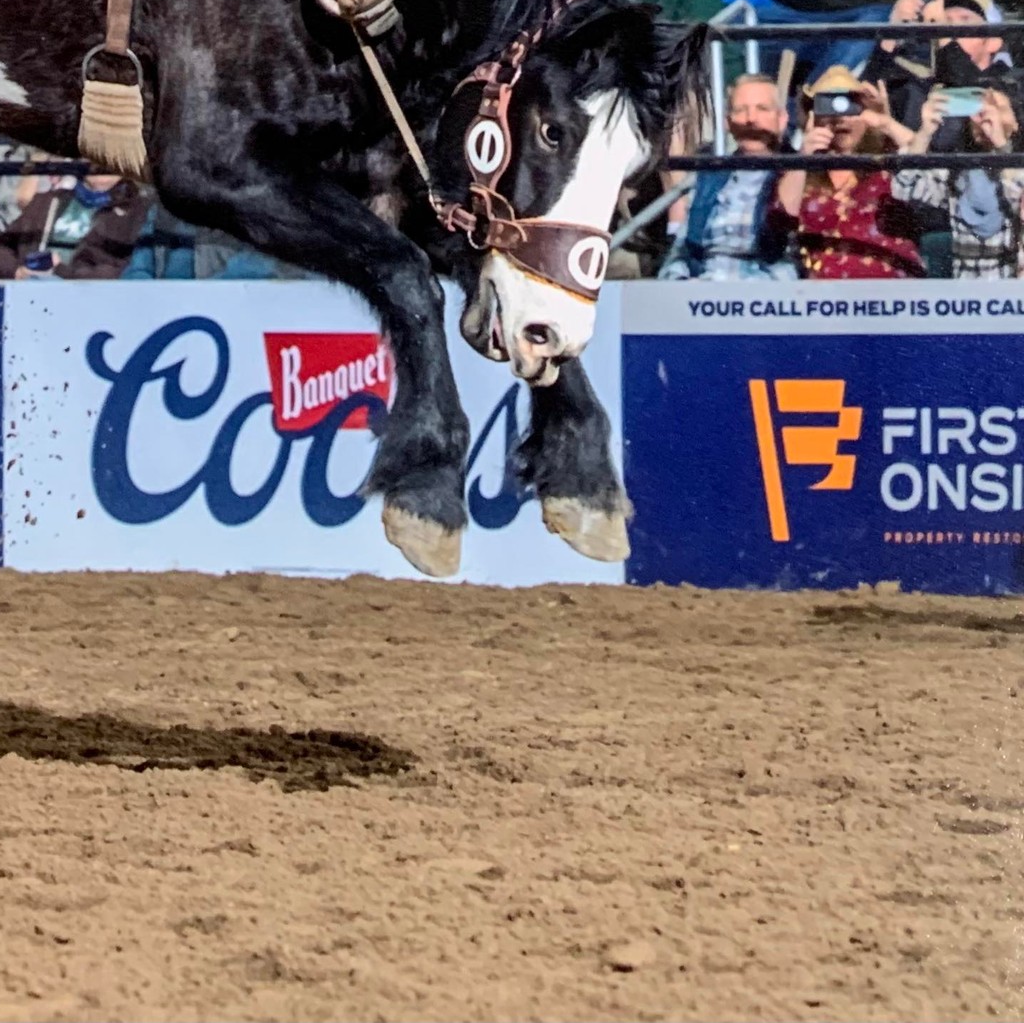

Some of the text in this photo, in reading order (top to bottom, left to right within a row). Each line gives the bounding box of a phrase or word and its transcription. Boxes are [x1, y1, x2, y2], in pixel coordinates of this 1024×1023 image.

[688, 300, 745, 317] YOUR
[749, 300, 802, 317] CALL
[806, 300, 849, 317] FOR
[852, 299, 906, 316] HELP
[910, 299, 930, 316] IS
[934, 299, 982, 316] OUR
[280, 343, 387, 421] Banquet
[85, 316, 538, 530] Coos
[883, 531, 964, 545] PROPERTY
